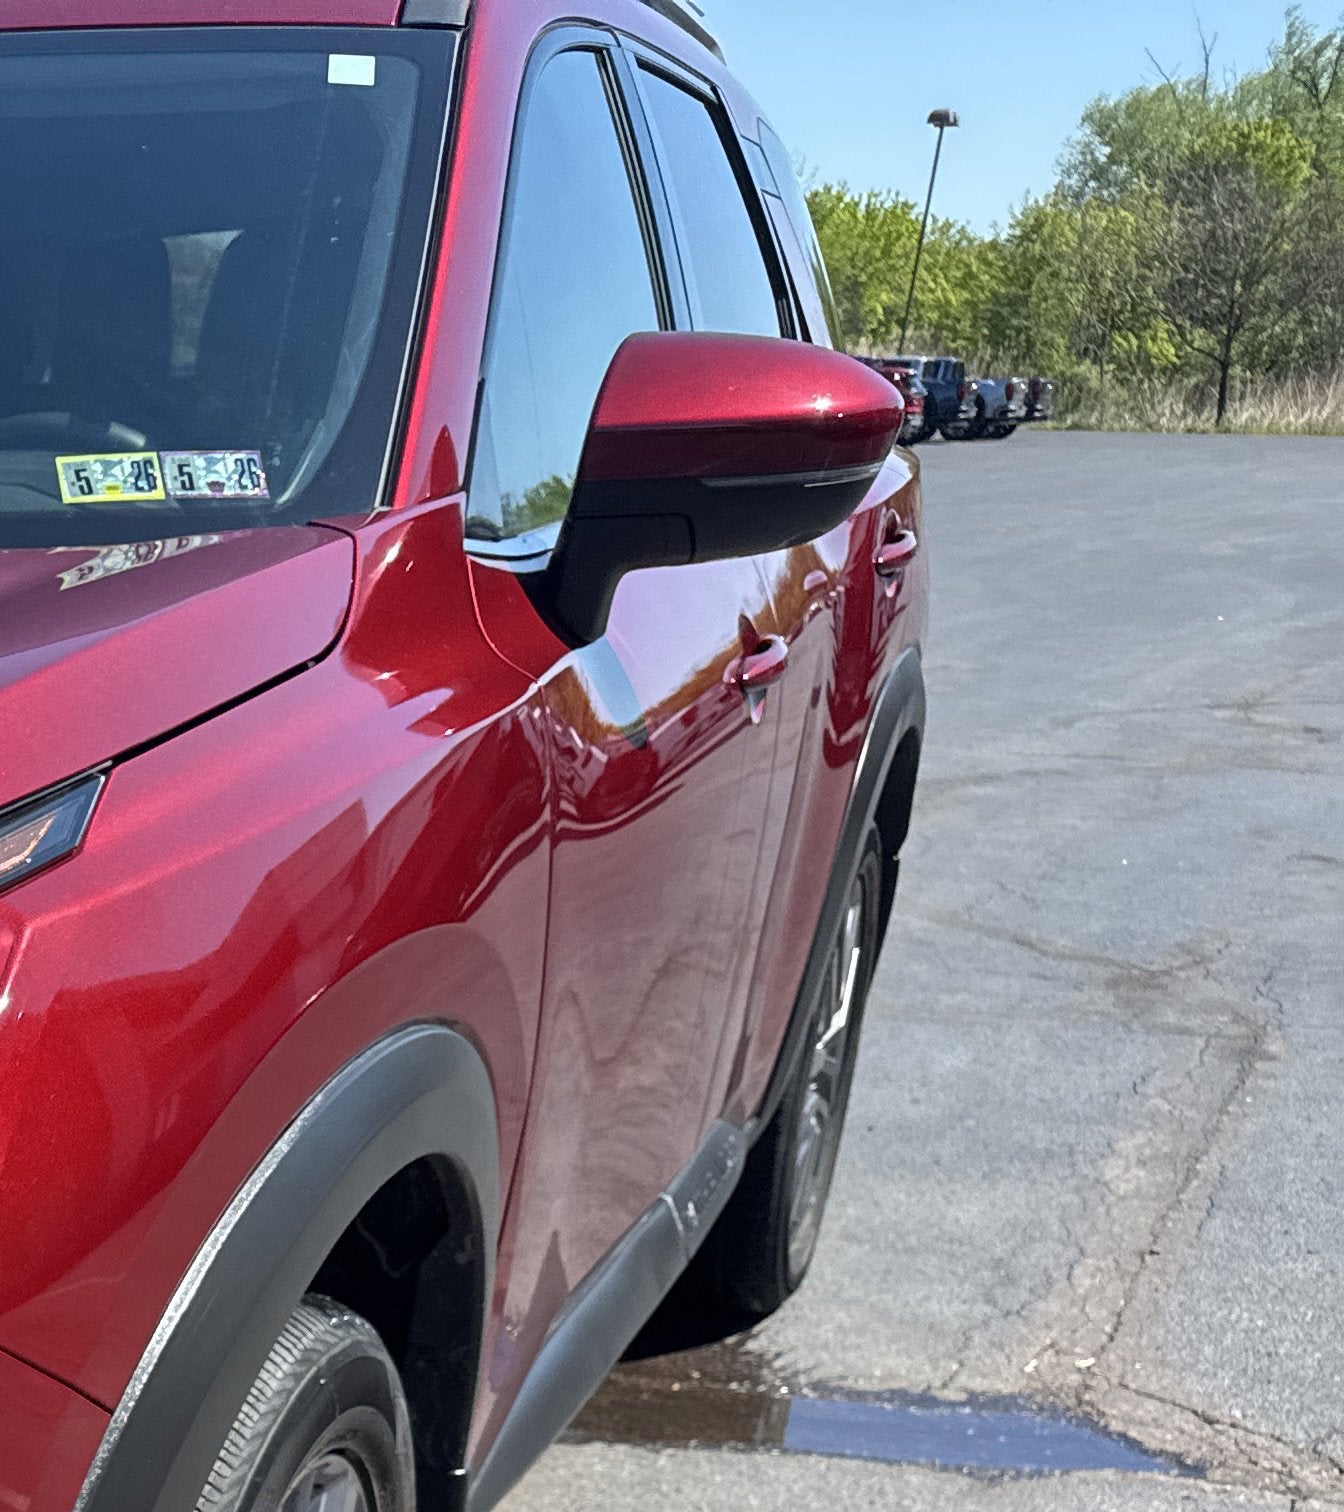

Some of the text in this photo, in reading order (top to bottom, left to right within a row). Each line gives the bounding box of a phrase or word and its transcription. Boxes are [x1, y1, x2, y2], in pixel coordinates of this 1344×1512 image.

[75, 459, 158, 496] 5 26
[178, 458, 262, 491] 5 26
